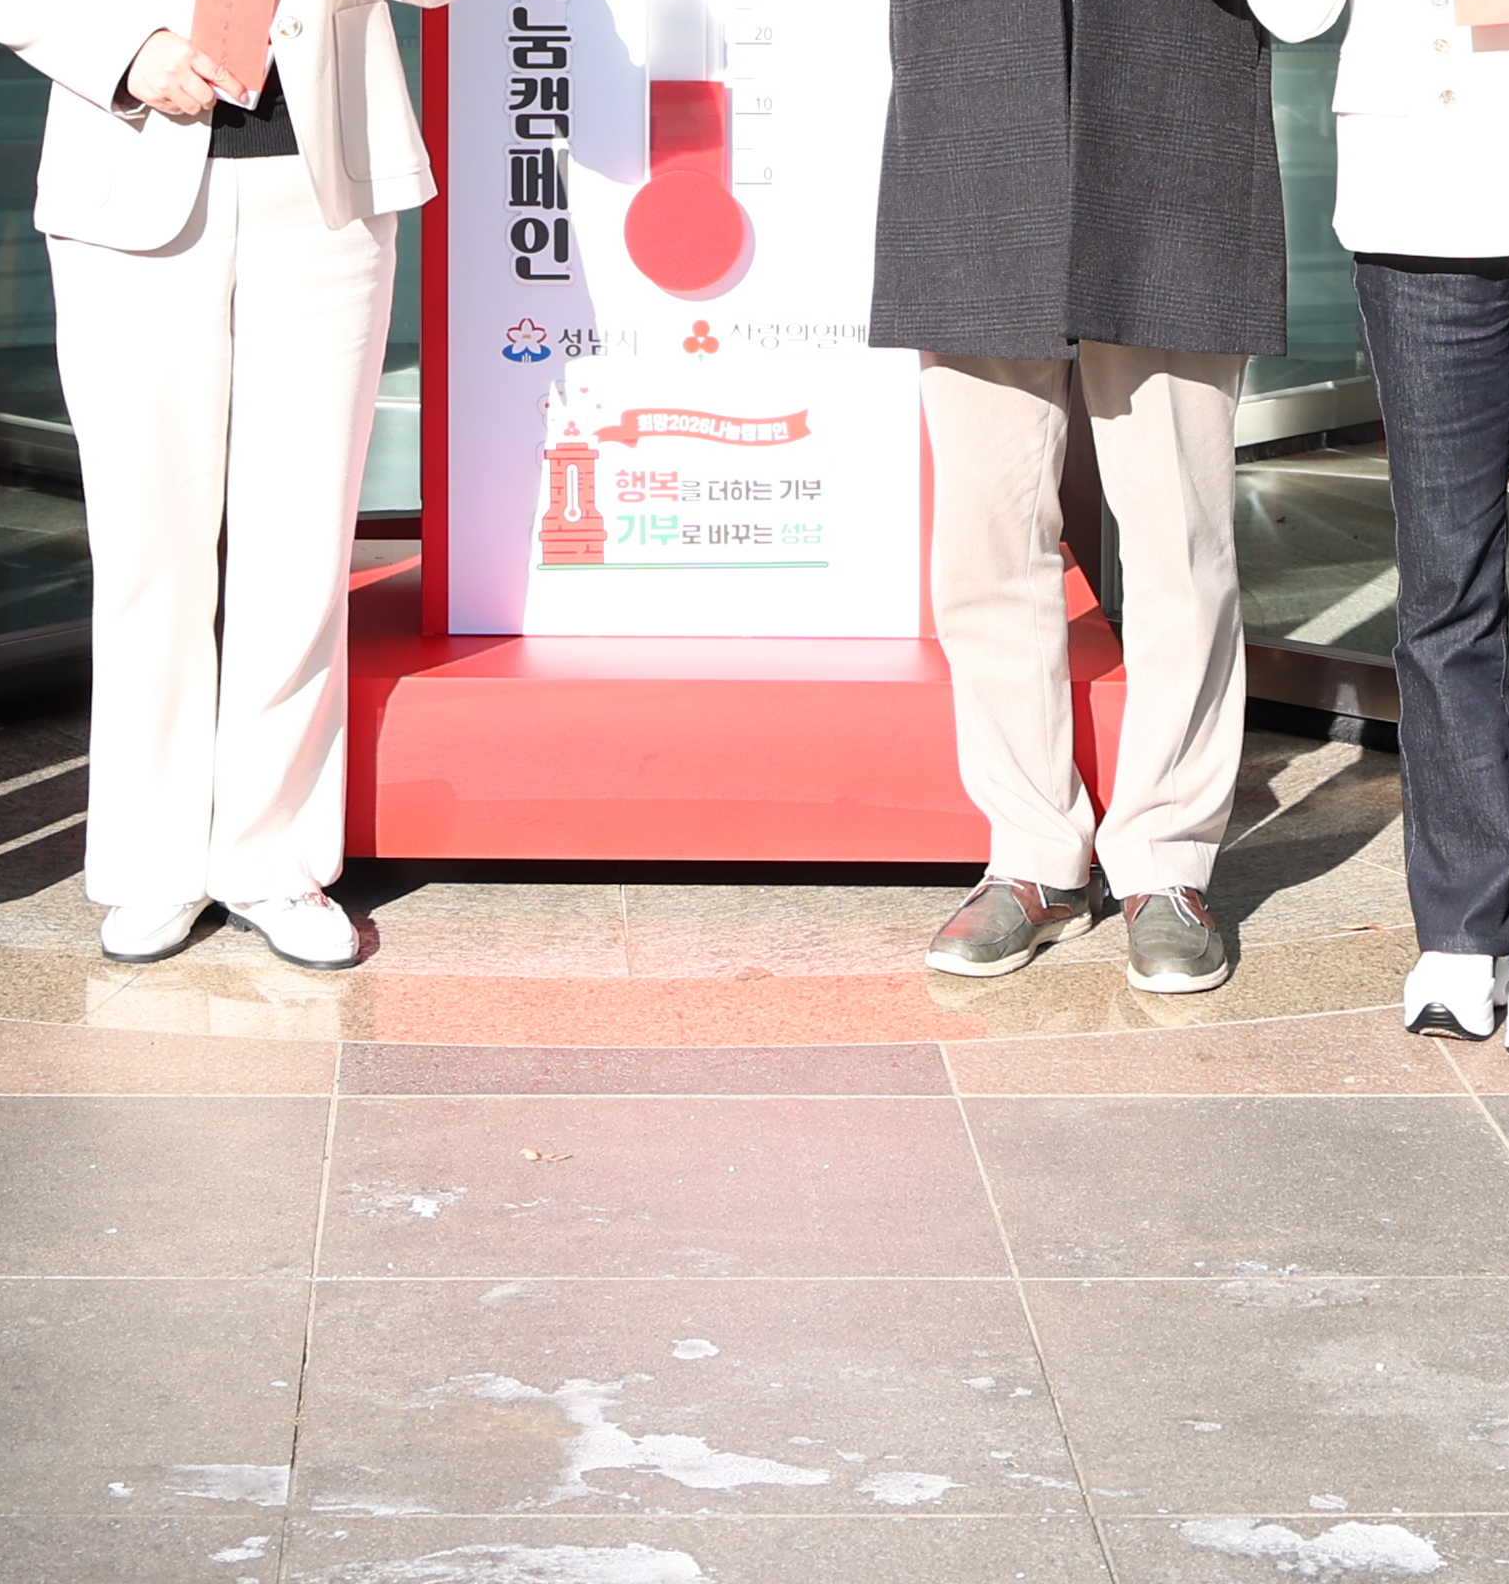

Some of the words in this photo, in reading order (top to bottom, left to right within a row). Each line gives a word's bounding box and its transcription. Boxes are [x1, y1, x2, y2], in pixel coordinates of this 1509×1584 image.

[755, 29, 772, 40] 20
[757, 98, 772, 110] 10
[558, 328, 638, 357] 성남시
[729, 323, 868, 350] 사랑의열매
[616, 470, 700, 502] 행복을
[709, 480, 772, 500] 더하는
[780, 480, 821, 500] 기부
[617, 515, 701, 545] 기부로
[709, 525, 772, 544] 바꾸는
[782, 524, 822, 543] 성남
